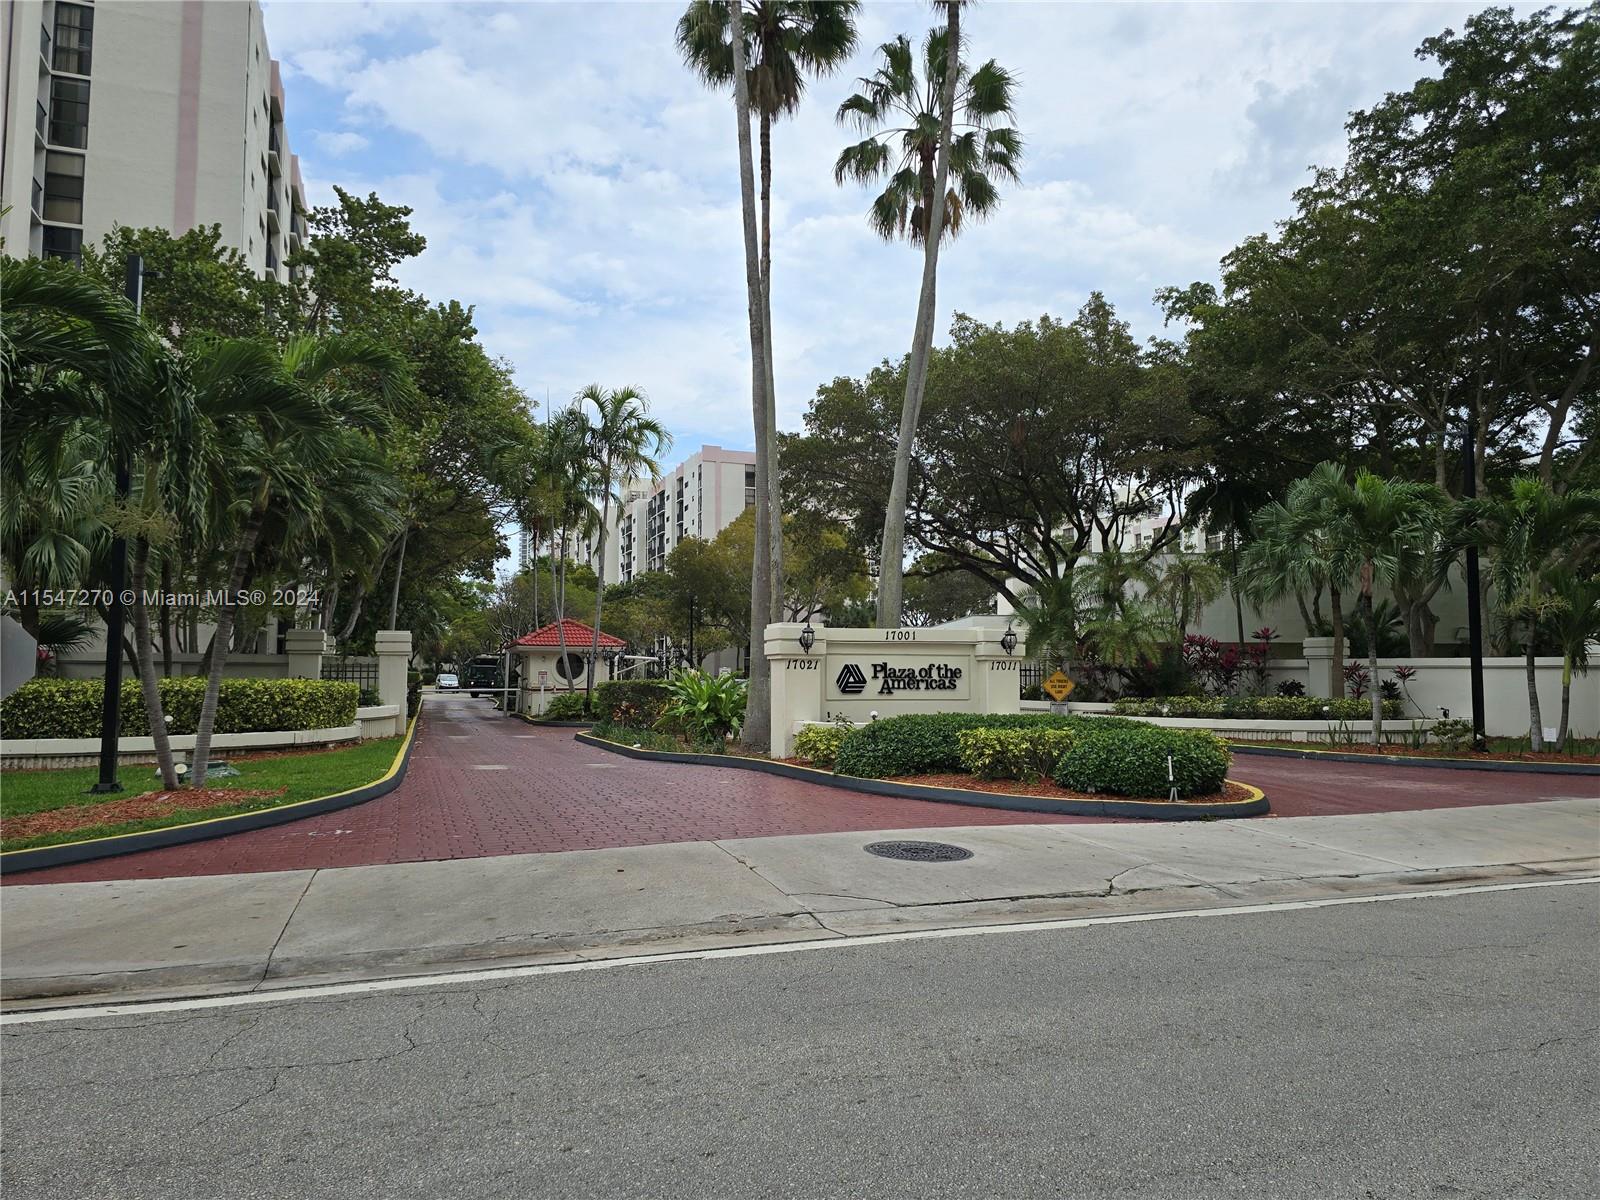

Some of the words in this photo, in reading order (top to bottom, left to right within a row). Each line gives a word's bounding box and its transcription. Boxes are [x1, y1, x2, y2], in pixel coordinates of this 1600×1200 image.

[885, 630, 916, 641] 17001
[786, 659, 819, 670] 17021
[991, 660, 1017, 671] 17011
[871, 662, 918, 679] Plaza
[918, 664, 936, 679] of
[936, 663, 962, 679] the
[878, 678, 957, 694] Americas
